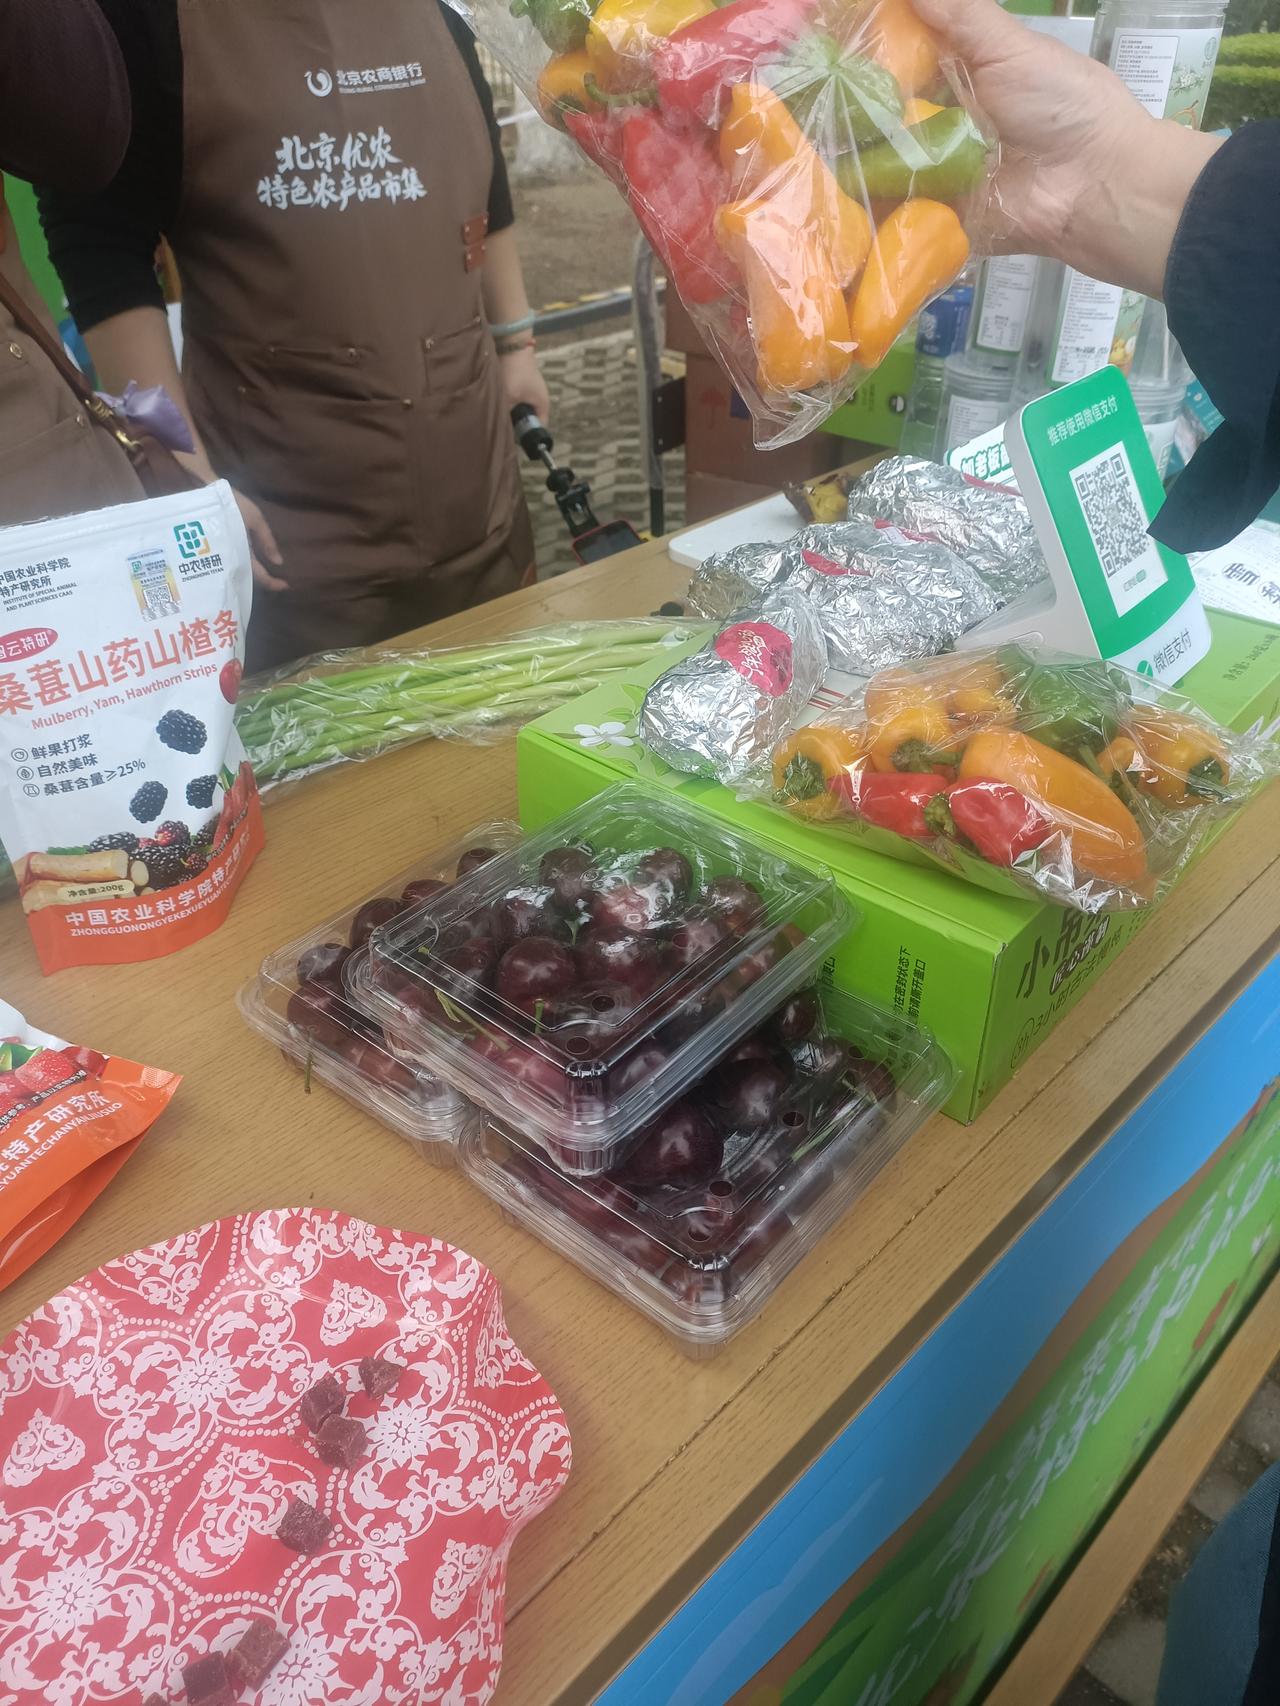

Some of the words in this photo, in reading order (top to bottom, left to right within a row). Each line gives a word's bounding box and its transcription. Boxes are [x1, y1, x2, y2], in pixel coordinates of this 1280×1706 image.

[337, 62, 423, 86] 北京农商银行
[275, 126, 403, 173] 北京优农
[257, 167, 428, 212] 特色农产品市集
[1047, 394, 1119, 447] 推荐使用微信支付
[178, 554, 223, 575] 中农特研
[0, 575, 52, 598] 特产研究所
[3, 595, 28, 605] INSTITUTE
[35, 588, 56, 597] SPECIAL
[57, 582, 77, 591] ANIMAL
[18, 599, 34, 608] PLANT
[35, 594, 58, 604] SCIENCES
[58, 590, 73, 598] CAAS
[0, 609, 239, 715] 桑葚山药山楂条
[1153, 628, 1192, 674] 微信支付
[32, 704, 94, 730] Mulberry,
[94, 694, 125, 711] Yam,
[125, 675, 183, 700] Hawthorn
[184, 661, 218, 681] Strips
[31, 733, 93, 760] 鲜果打浆
[38, 753, 98, 778] 自然美味
[44, 758, 146, 796] 桑葚含量≥25%
